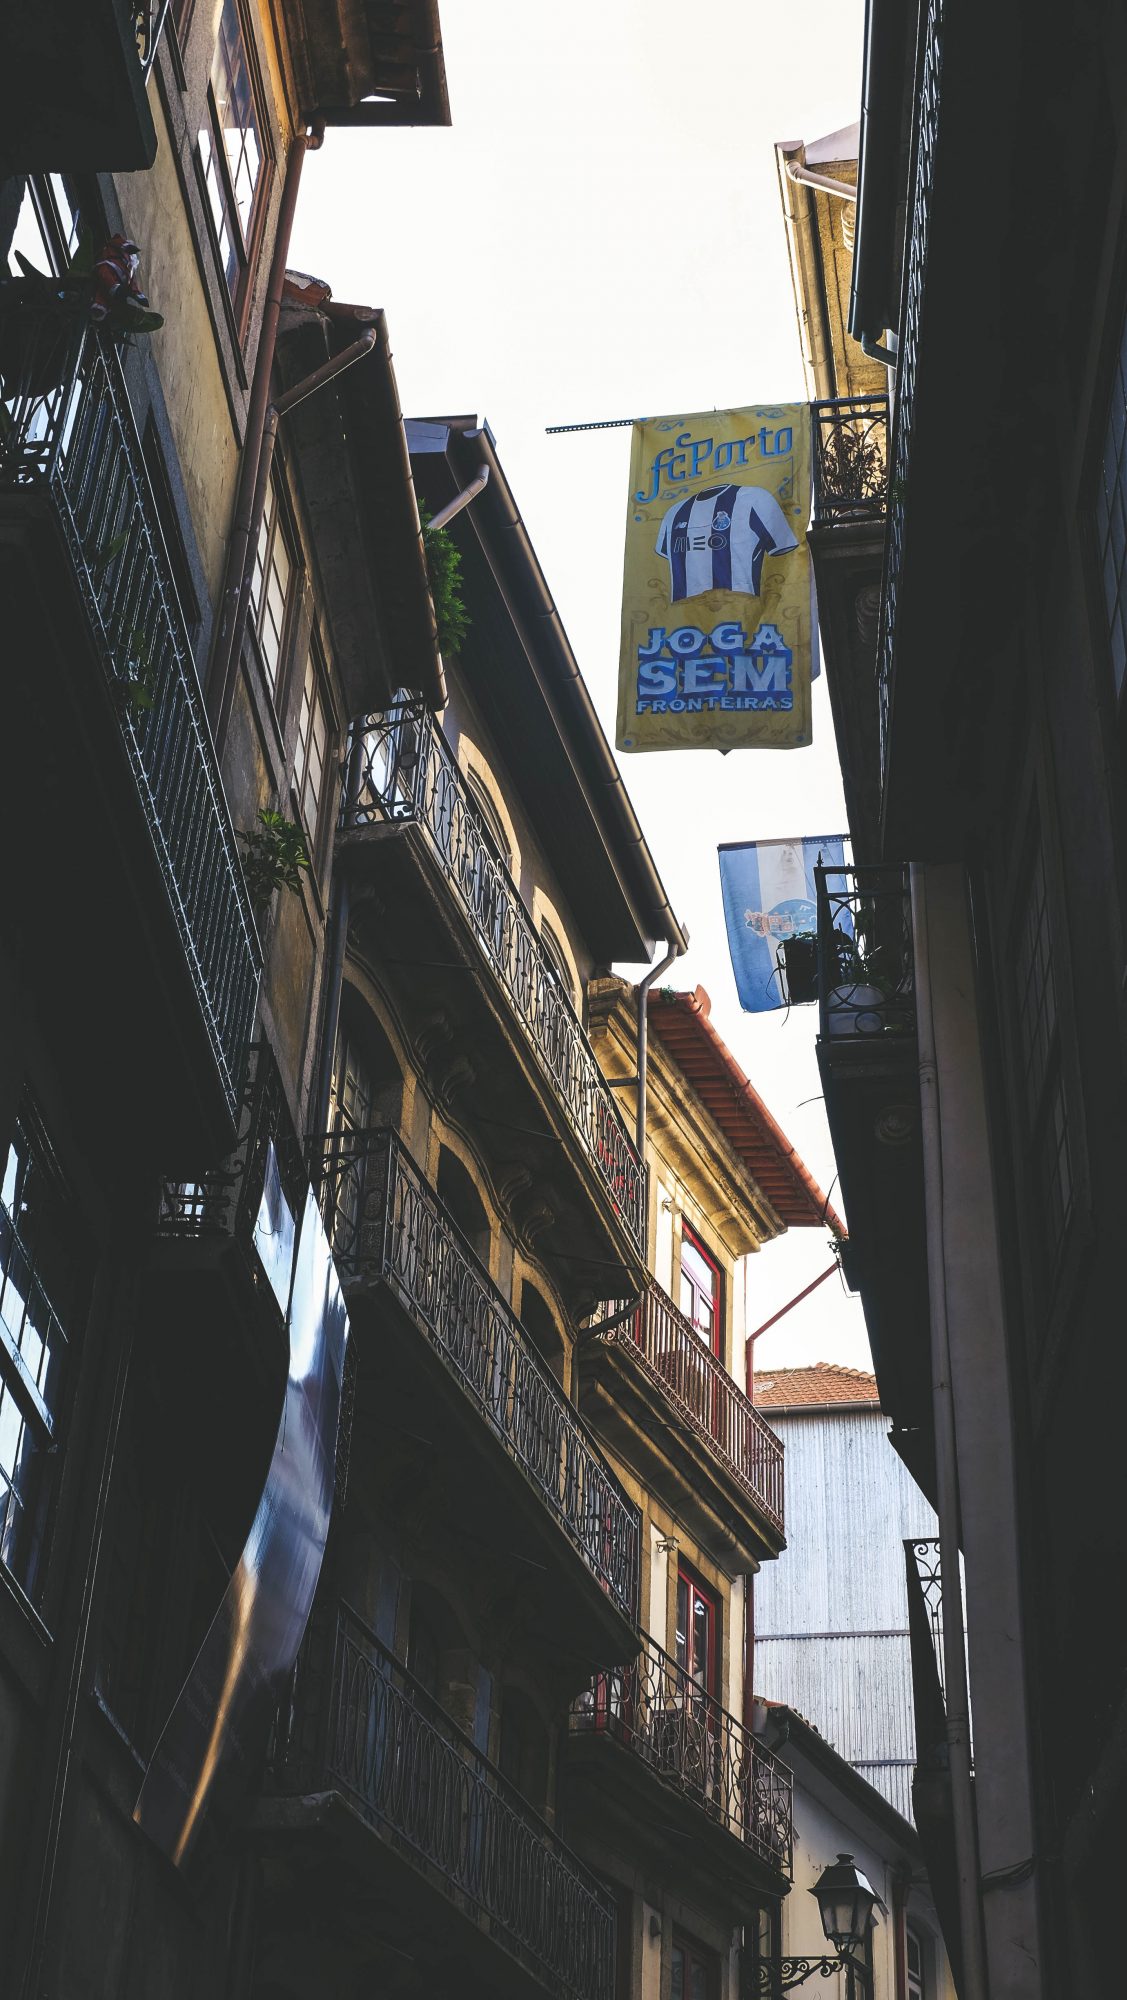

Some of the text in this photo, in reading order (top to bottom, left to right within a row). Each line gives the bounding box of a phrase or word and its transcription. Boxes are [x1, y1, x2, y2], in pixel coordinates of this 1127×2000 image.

[638, 621, 792, 657] JOGA
[637, 655, 793, 698] SEM
[636, 696, 793, 715] FRONTEIRAS
